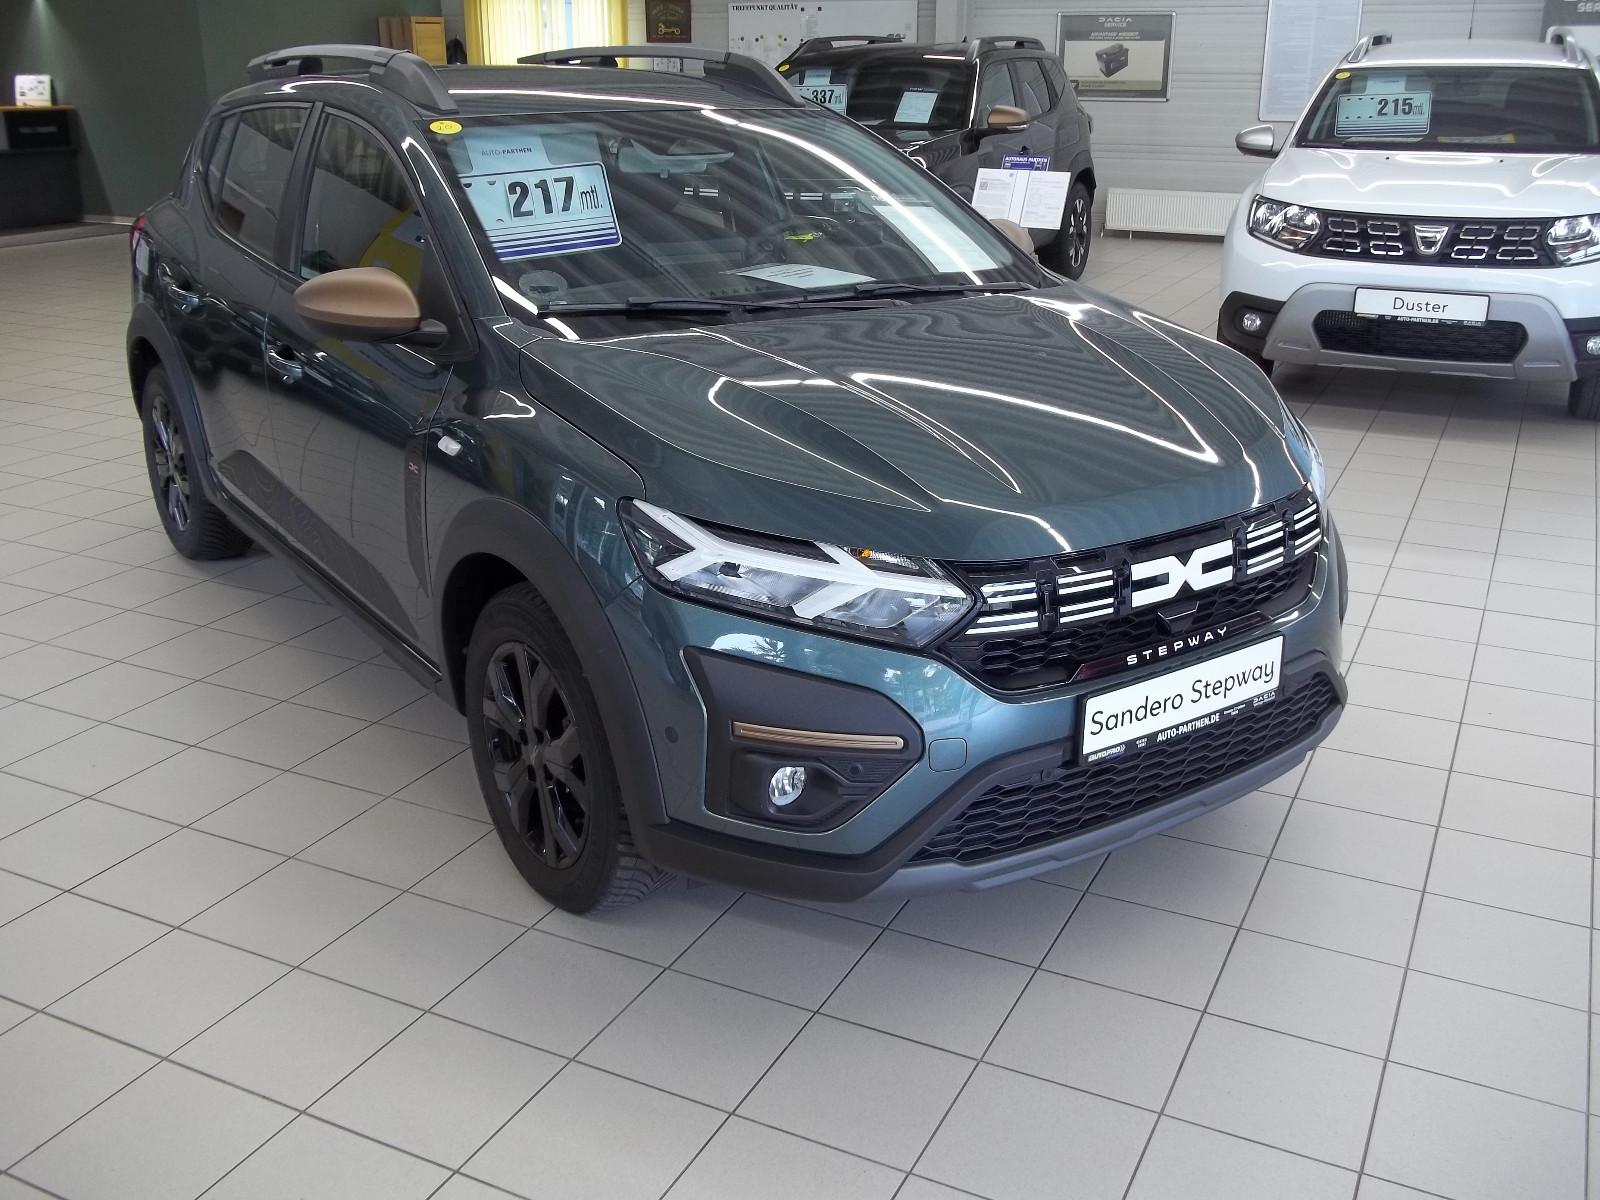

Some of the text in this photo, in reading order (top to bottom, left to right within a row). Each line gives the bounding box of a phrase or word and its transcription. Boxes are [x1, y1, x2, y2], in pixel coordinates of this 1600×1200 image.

[769, 3, 798, 11] QUALITÄT
[811, 89, 835, 104] 337
[1377, 97, 1414, 117] 215
[508, 175, 603, 218] 217 mtl.
[1393, 296, 1449, 314] Duster
[1126, 626, 1228, 666] STEPWAY
[1090, 659, 1276, 735] Sandero Stepway
[1253, 691, 1276, 703] DACIA
[1156, 712, 1220, 743] AUTO-PARTHEN.DE
